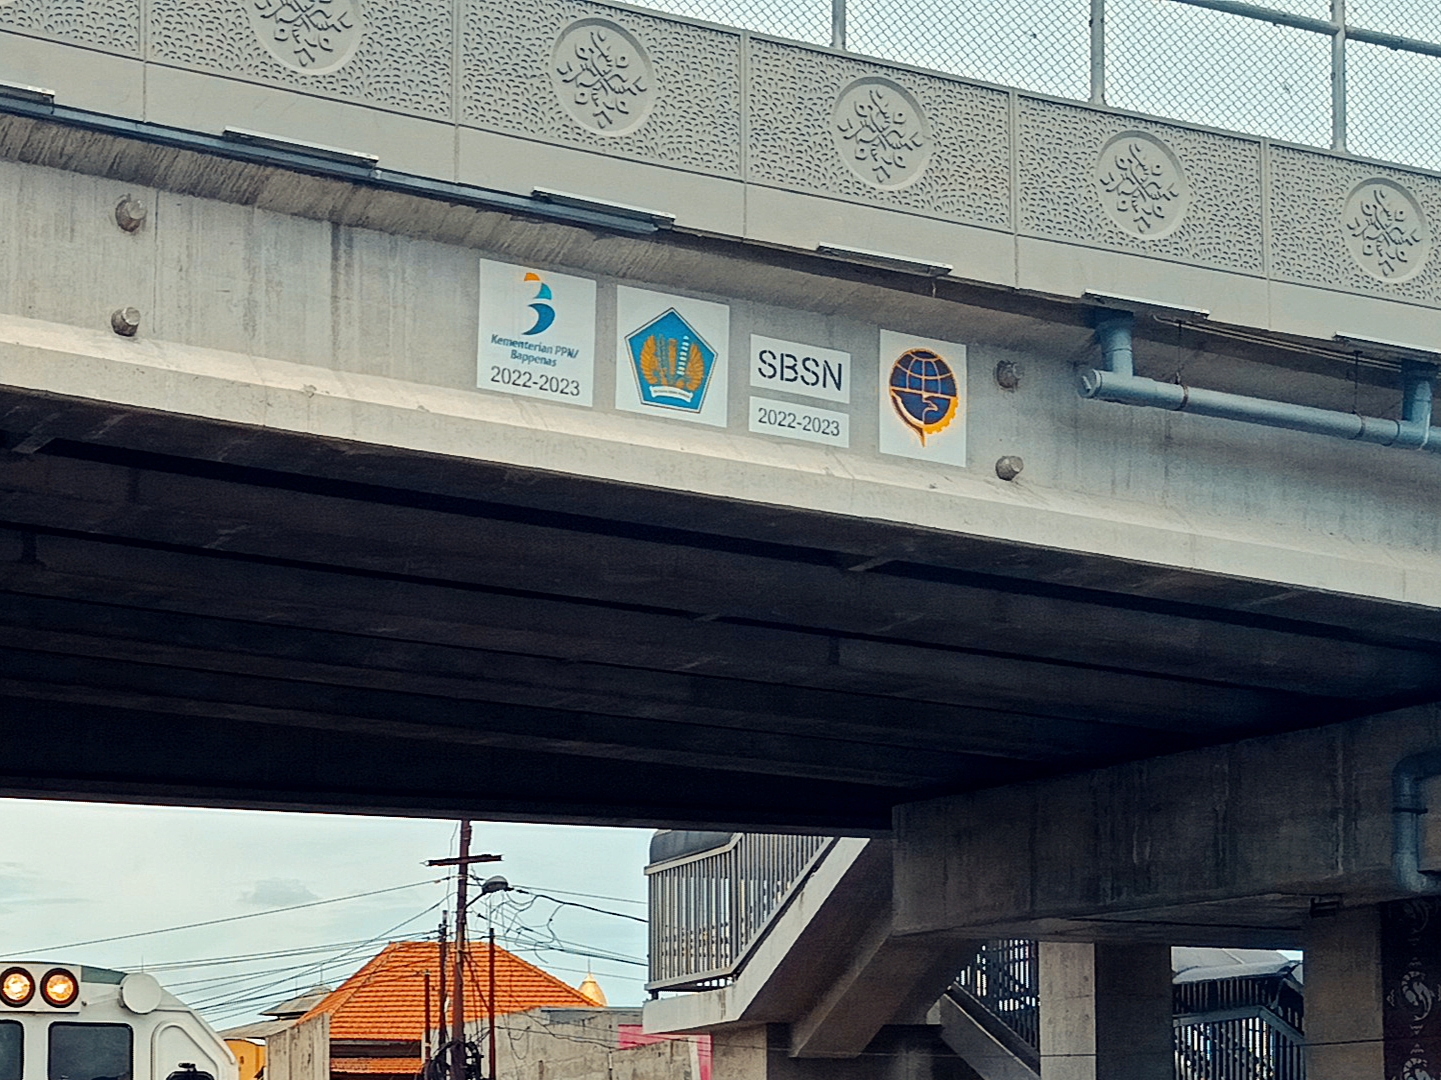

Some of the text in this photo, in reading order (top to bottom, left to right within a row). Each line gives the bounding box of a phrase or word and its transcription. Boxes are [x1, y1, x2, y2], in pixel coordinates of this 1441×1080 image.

[491, 334, 579, 359] Kementerian PPN/
[510, 349, 557, 367] Bappenas
[490, 365, 580, 397] 2022-2023
[758, 349, 842, 391] SBSN
[758, 407, 840, 436] 2022-2023
